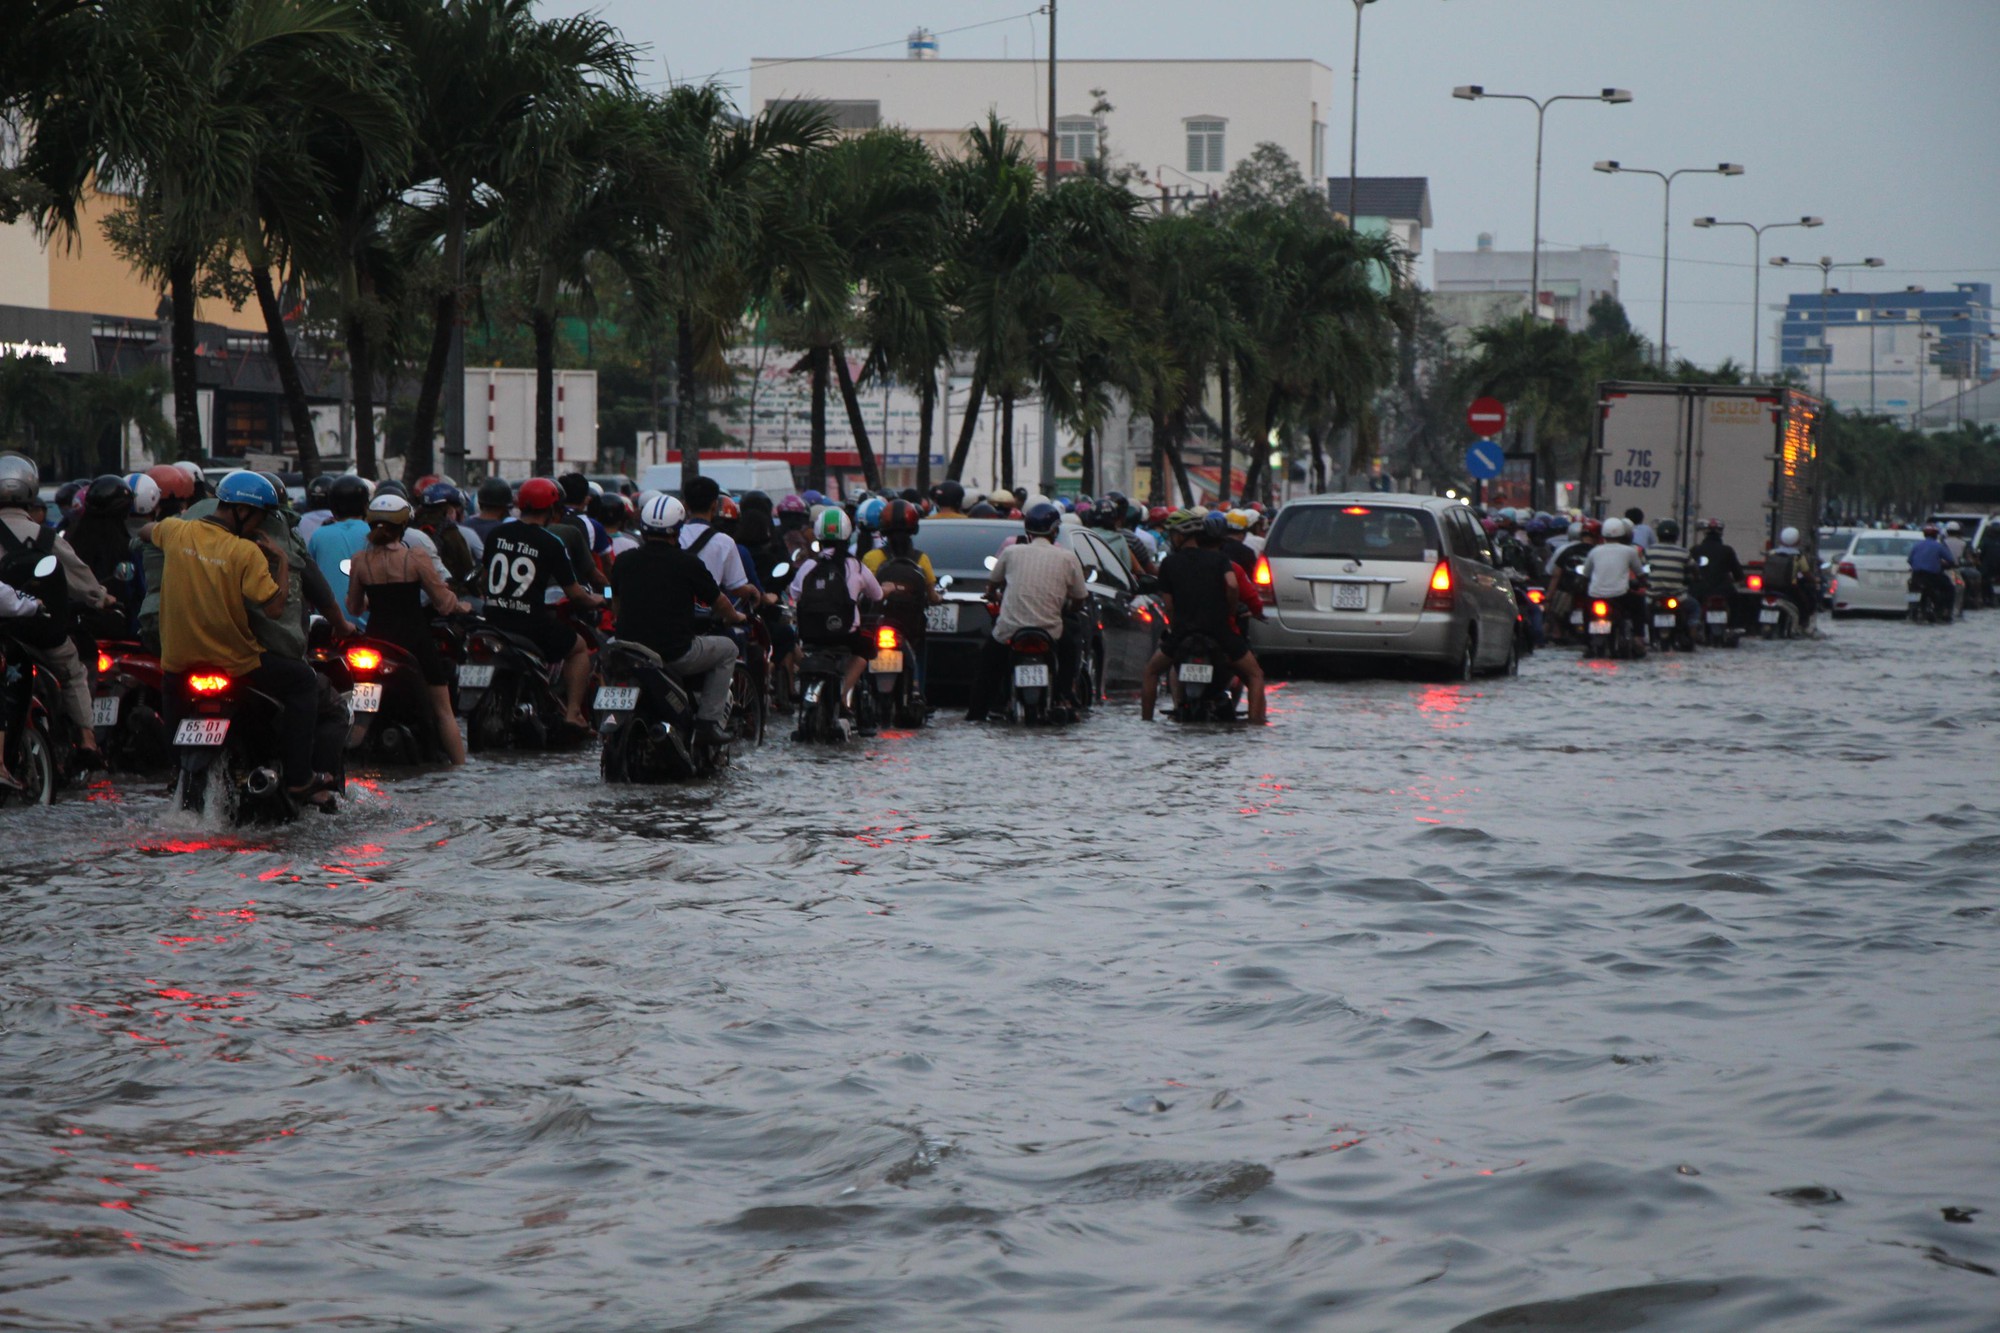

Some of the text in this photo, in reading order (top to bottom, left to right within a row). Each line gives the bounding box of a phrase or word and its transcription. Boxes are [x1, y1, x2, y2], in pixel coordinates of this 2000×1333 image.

[1711, 401, 1761, 415] ISUZU
[1627, 449, 1652, 467] 71C
[1615, 469, 1661, 488] 04297
[497, 538, 539, 557] Thu Tâm
[488, 552, 536, 597] 09
[604, 688, 632, 698] 65-B1
